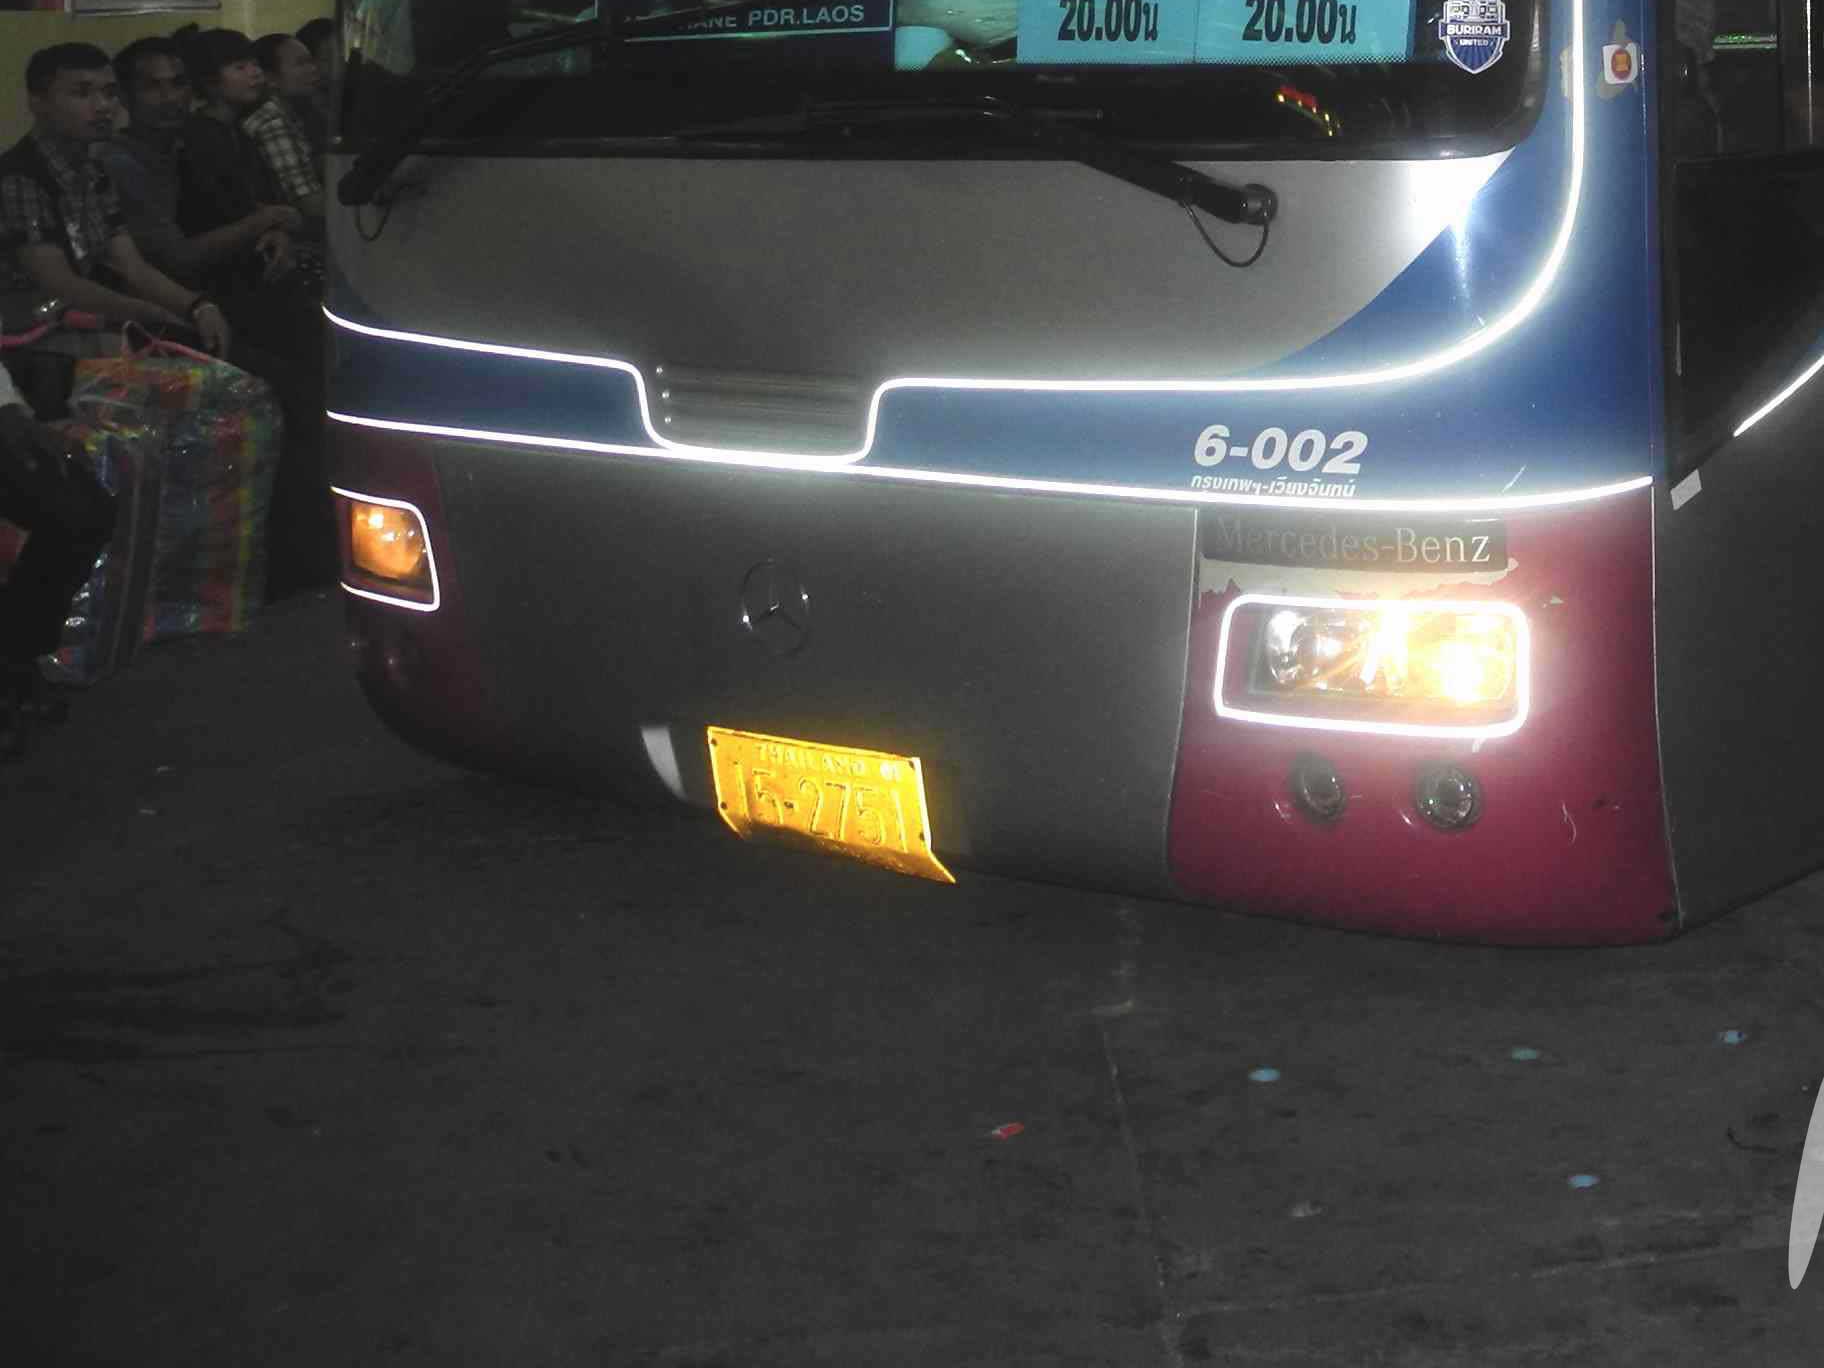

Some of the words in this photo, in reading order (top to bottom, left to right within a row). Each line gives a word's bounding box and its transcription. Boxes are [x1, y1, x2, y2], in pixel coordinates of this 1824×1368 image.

[748, 4, 866, 27] PDR.LAOS
[1446, 24, 1502, 36] BURIRAM
[1459, 38, 1489, 47] UNITED
[1193, 423, 1369, 475] 6-002
[1215, 515, 1490, 563] Mercedes-Benz
